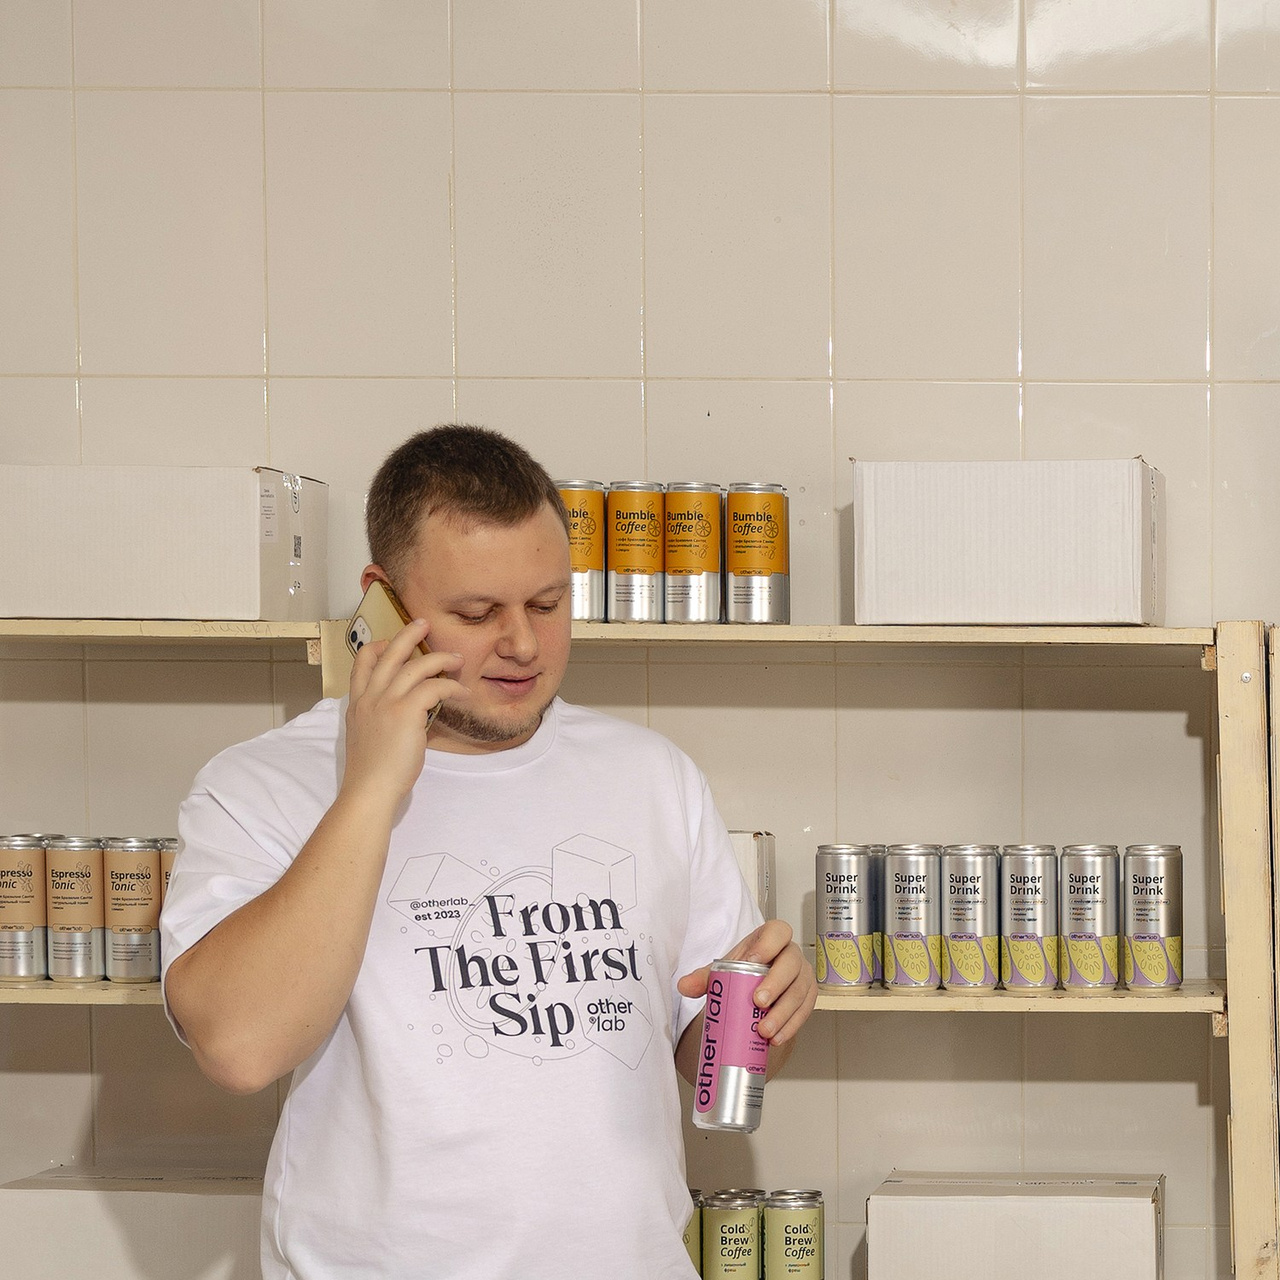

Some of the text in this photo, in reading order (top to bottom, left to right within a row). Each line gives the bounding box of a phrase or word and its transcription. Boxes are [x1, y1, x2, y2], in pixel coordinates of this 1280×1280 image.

[616, 510, 655, 520] Bumble
[667, 511, 704, 521] Bumble
[733, 513, 772, 522] Bumble
[616, 521, 646, 534] Coffee
[667, 523, 694, 535] Coffee
[733, 524, 763, 536] Coffee
[0, 870, 32, 880] presso
[51, 869, 91, 879] Espresso
[111, 871, 151, 881] Espresso
[826, 873, 858, 883] Super
[895, 873, 927, 883] Super
[950, 873, 982, 884] Super
[1010, 874, 1042, 885] Super
[1069, 874, 1101, 885] Super
[1132, 875, 1164, 885] Super
[51, 880, 75, 890] Tonic
[111, 882, 136, 891] Tonic
[826, 884, 857, 894] Drink
[895, 885, 926, 894] Drink
[950, 885, 980, 895] Drink
[1010, 885, 1041, 895] Drink
[1069, 885, 1100, 895] Drink
[1133, 886, 1163, 895] Drink
[415, 910, 461, 921] est 2023
[484, 894, 623, 937] From
[415, 940, 642, 992] The First
[587, 999, 633, 1014] other
[489, 992, 575, 1047] Sip
[721, 1224, 745, 1234] Cold
[784, 1225, 809, 1234] Cold
[721, 1236, 749, 1245] Brew
[785, 1236, 813, 1245] Brew
[721, 1247, 752, 1259] Coffee
[784, 1247, 815, 1259] Coffee
